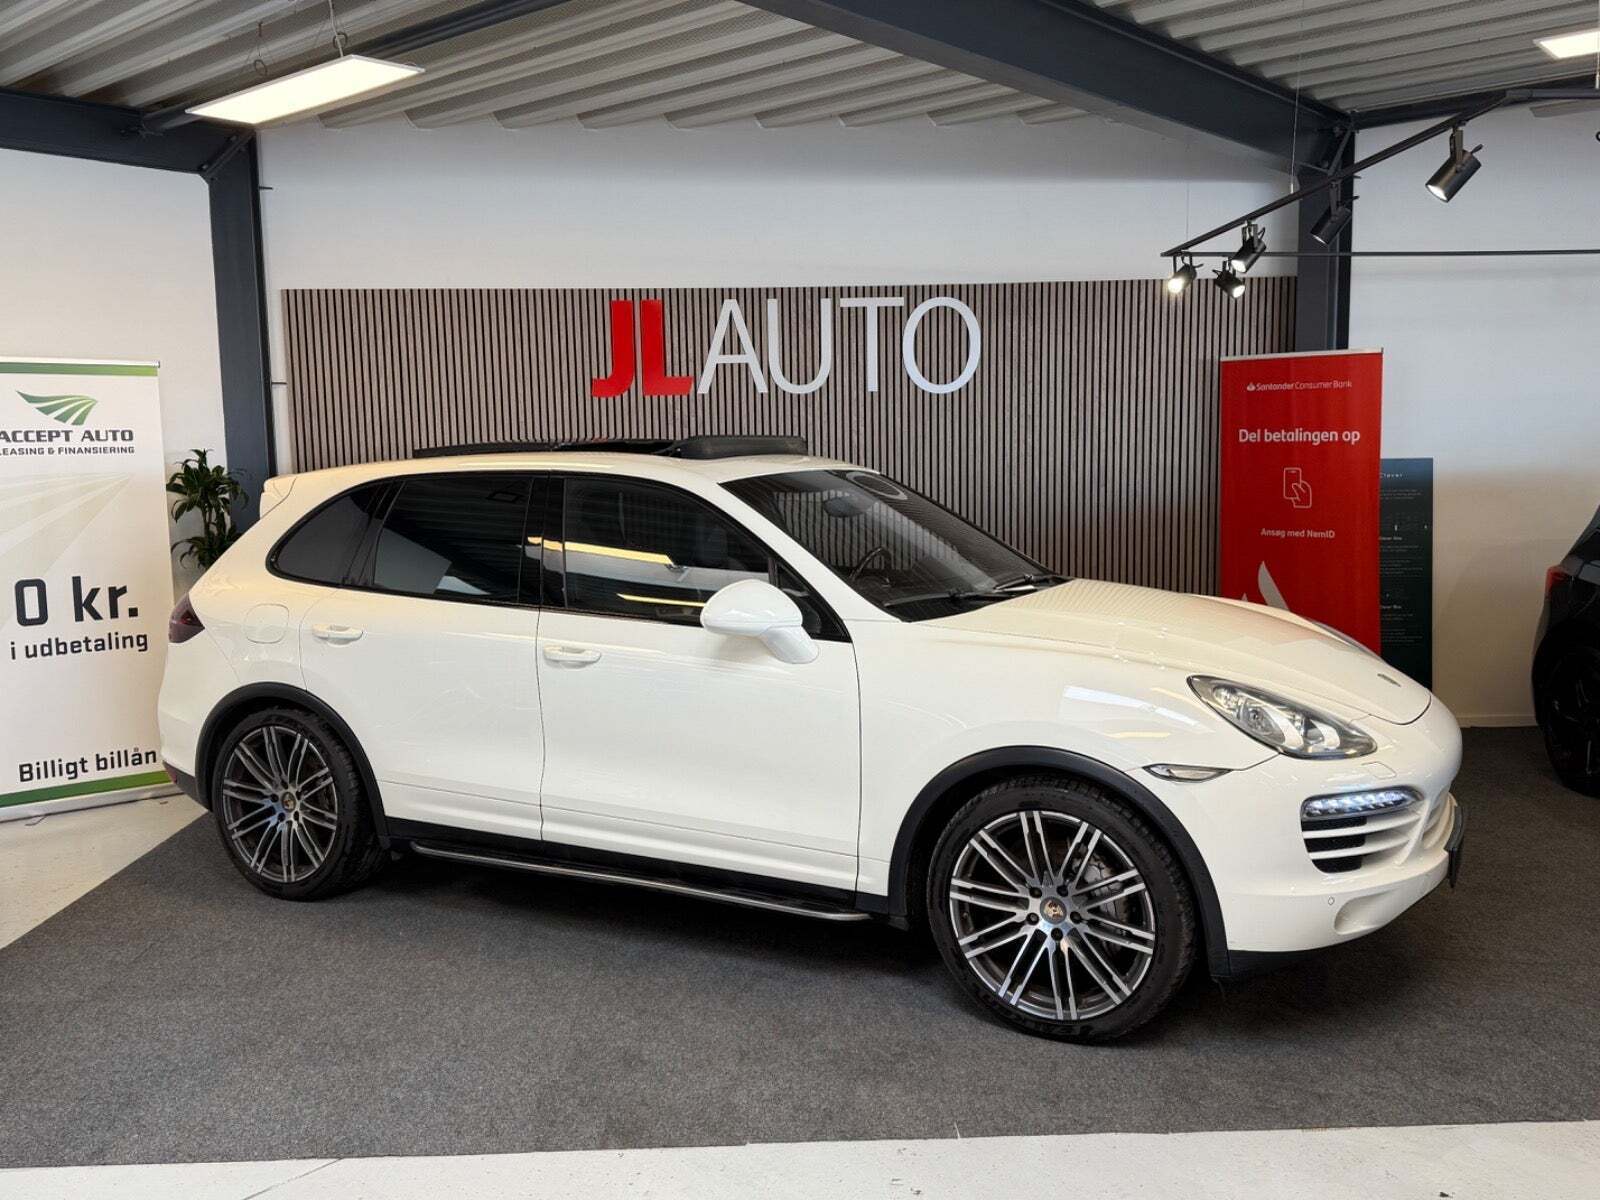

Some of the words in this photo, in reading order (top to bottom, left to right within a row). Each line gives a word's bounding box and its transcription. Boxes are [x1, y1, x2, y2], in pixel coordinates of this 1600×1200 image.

[0, 430, 73, 443] ACCEPT
[81, 429, 134, 442] AUTO
[1238, 428, 1261, 443] Del
[1264, 427, 1338, 446] betalingen
[1341, 430, 1361, 445] op
[47, 447, 55, 455] &
[58, 446, 135, 455] FINANSIERING
[1287, 529, 1305, 538] med
[1306, 529, 1336, 539] NemID
[14, 578, 49, 627] 0
[71, 575, 139, 623] kr.
[10, 641, 16, 660] i
[25, 632, 148, 659] udbetaling
[18, 759, 88, 783] Billigt
[95, 747, 157, 772] billån
